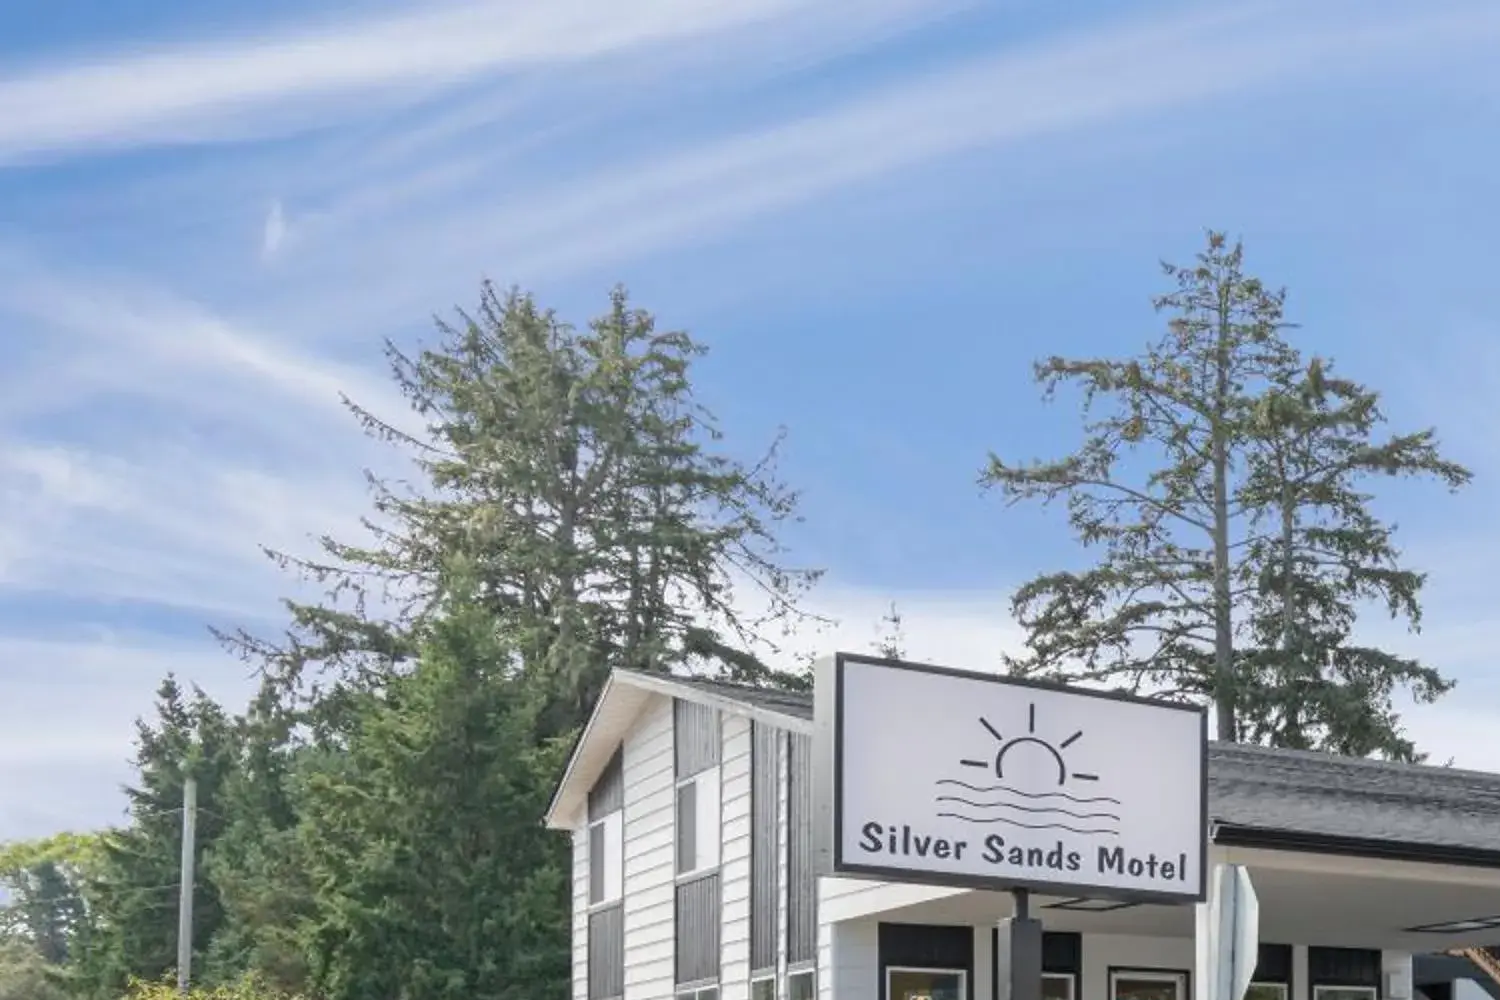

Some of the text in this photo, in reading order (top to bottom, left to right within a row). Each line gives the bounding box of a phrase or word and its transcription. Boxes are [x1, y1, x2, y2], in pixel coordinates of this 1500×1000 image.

[860, 821, 1187, 881] Silver Sands Motel
